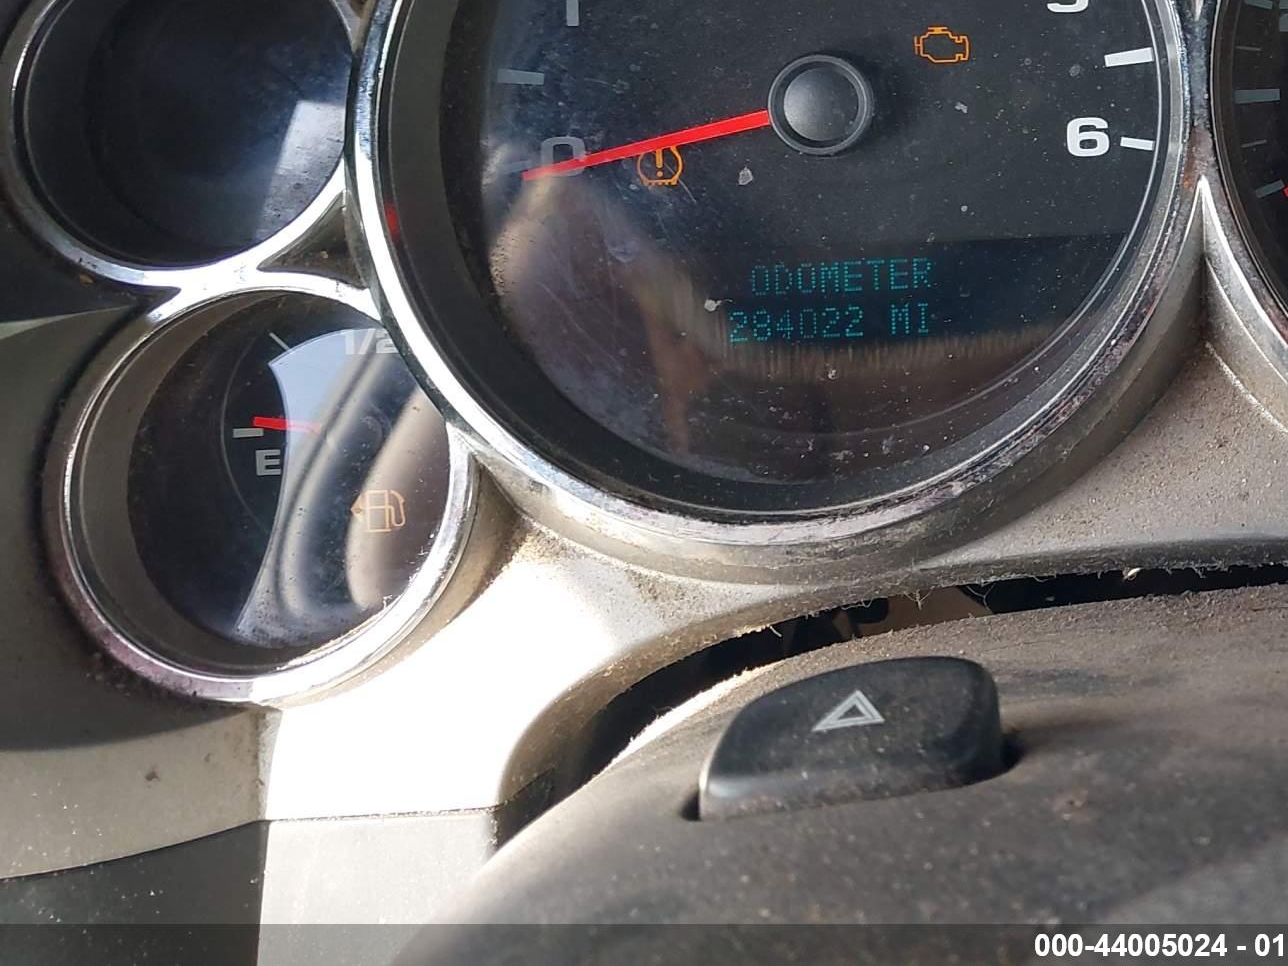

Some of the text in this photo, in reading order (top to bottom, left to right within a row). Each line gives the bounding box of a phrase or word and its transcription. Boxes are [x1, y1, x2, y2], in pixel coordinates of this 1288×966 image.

[539, 136, 587, 178] 0
[1065, 117, 1110, 157] 6
[751, 257, 932, 296] ODOMETER
[729, 302, 929, 345] 284022 MI
[255, 449, 281, 476] E
